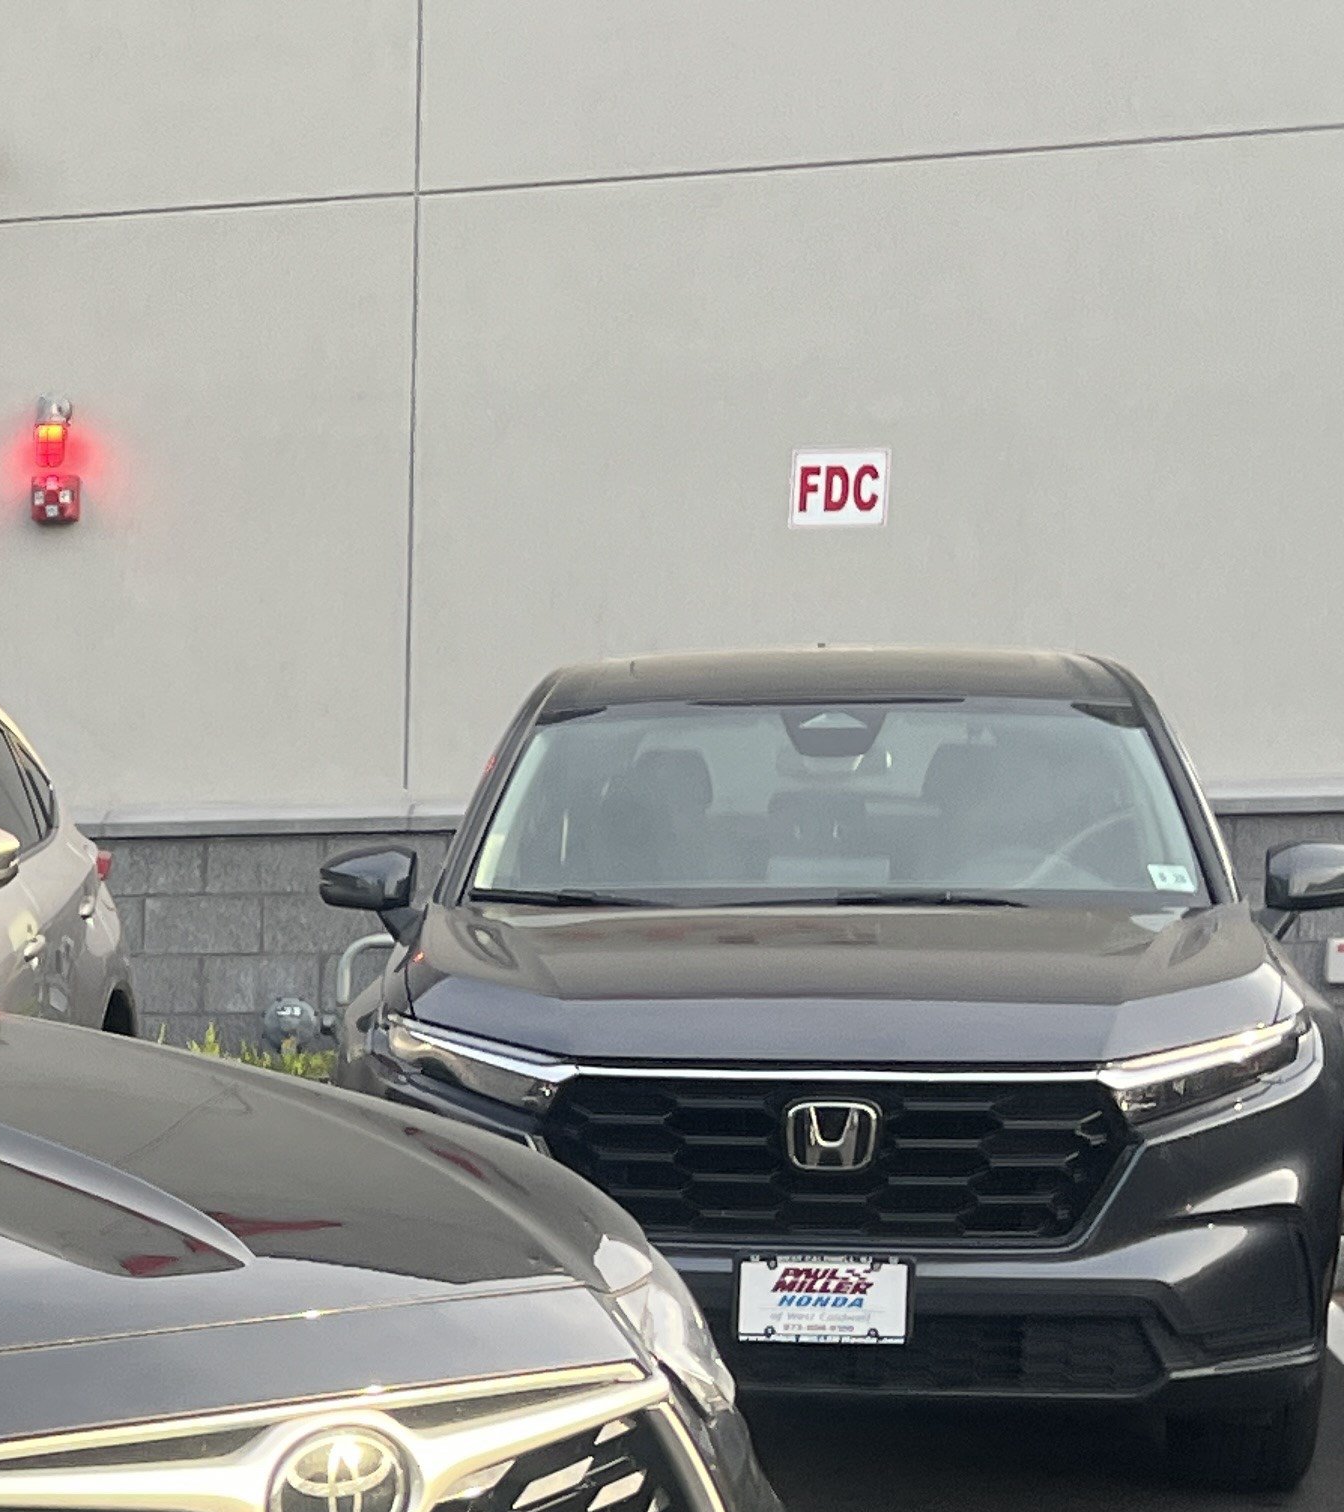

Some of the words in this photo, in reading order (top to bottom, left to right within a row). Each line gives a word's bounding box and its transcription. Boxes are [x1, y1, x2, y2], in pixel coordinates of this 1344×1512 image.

[799, 464, 879, 512] FDC
[780, 1267, 846, 1280] PAUL
[771, 1280, 874, 1294] MILLER
[778, 1295, 865, 1308] HONDA
